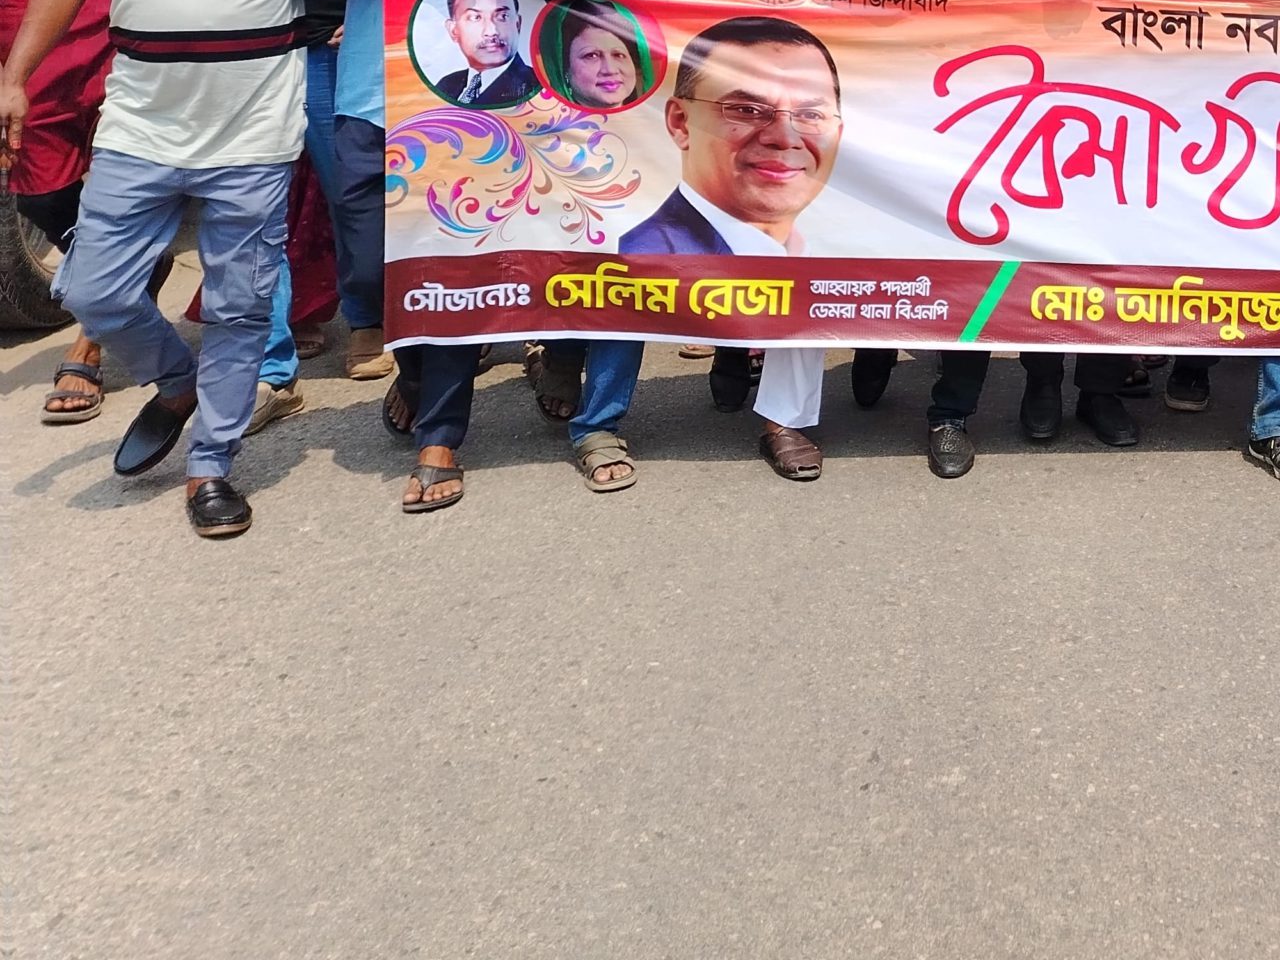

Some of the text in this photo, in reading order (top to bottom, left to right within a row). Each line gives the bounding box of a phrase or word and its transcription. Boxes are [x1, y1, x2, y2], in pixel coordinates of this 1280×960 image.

[1097, 5, 1211, 51] বাংলা
[402, 261, 795, 319] সৌজন্যেঃ সেলিম রেজা
[880, 275, 932, 297] পদপ্রার্থী
[1029, 281, 1105, 325] মোঃ
[809, 298, 949, 320] ডেমরা থানা বিএনপি
